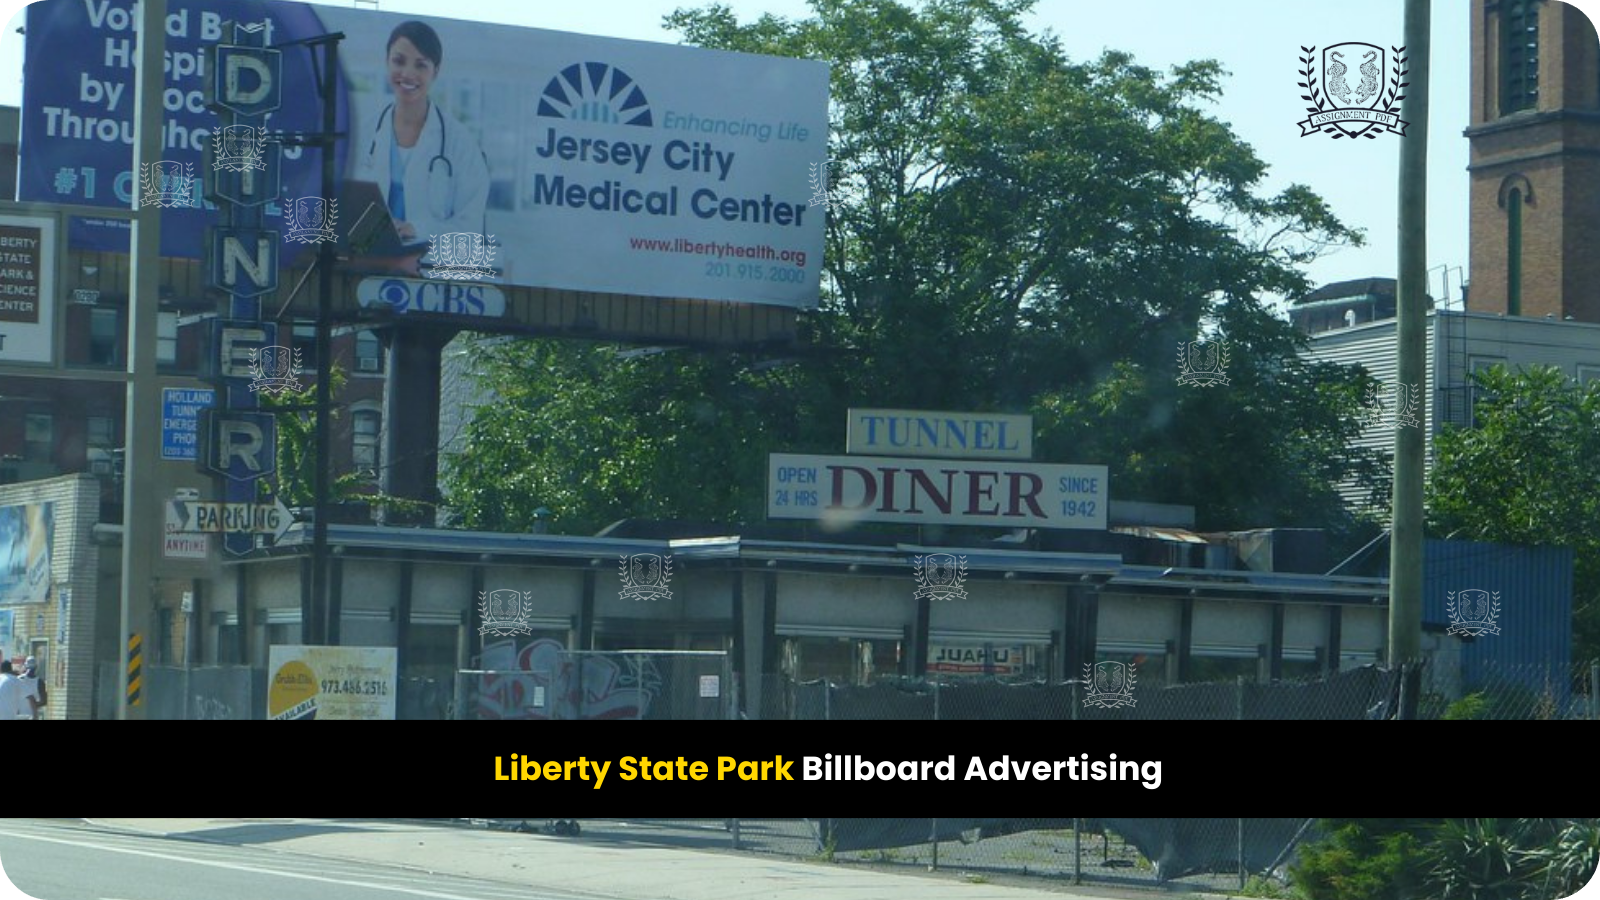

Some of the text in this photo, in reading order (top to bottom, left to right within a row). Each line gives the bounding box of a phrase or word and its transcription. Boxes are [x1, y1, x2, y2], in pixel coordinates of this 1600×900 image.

[80, 72, 124, 111] by
[662, 110, 810, 142] Enhancing Life
[536, 127, 735, 181] Jersey City
[54, 167, 95, 198] #1
[533, 173, 807, 227] Medical Center
[630, 236, 807, 266] www.libertyhealth.org
[705, 261, 806, 284] 201.915.2000
[416, 282, 487, 316] CBS
[167, 391, 212, 404] HOLLAND
[860, 415, 1020, 452] TUNNEL
[777, 465, 817, 484] OPEN
[1059, 475, 1099, 495] SINCE
[775, 489, 818, 507] 24 HRS
[825, 464, 1049, 519] DINER
[196, 505, 281, 531] PARKING
[1060, 499, 1097, 518] 1942
